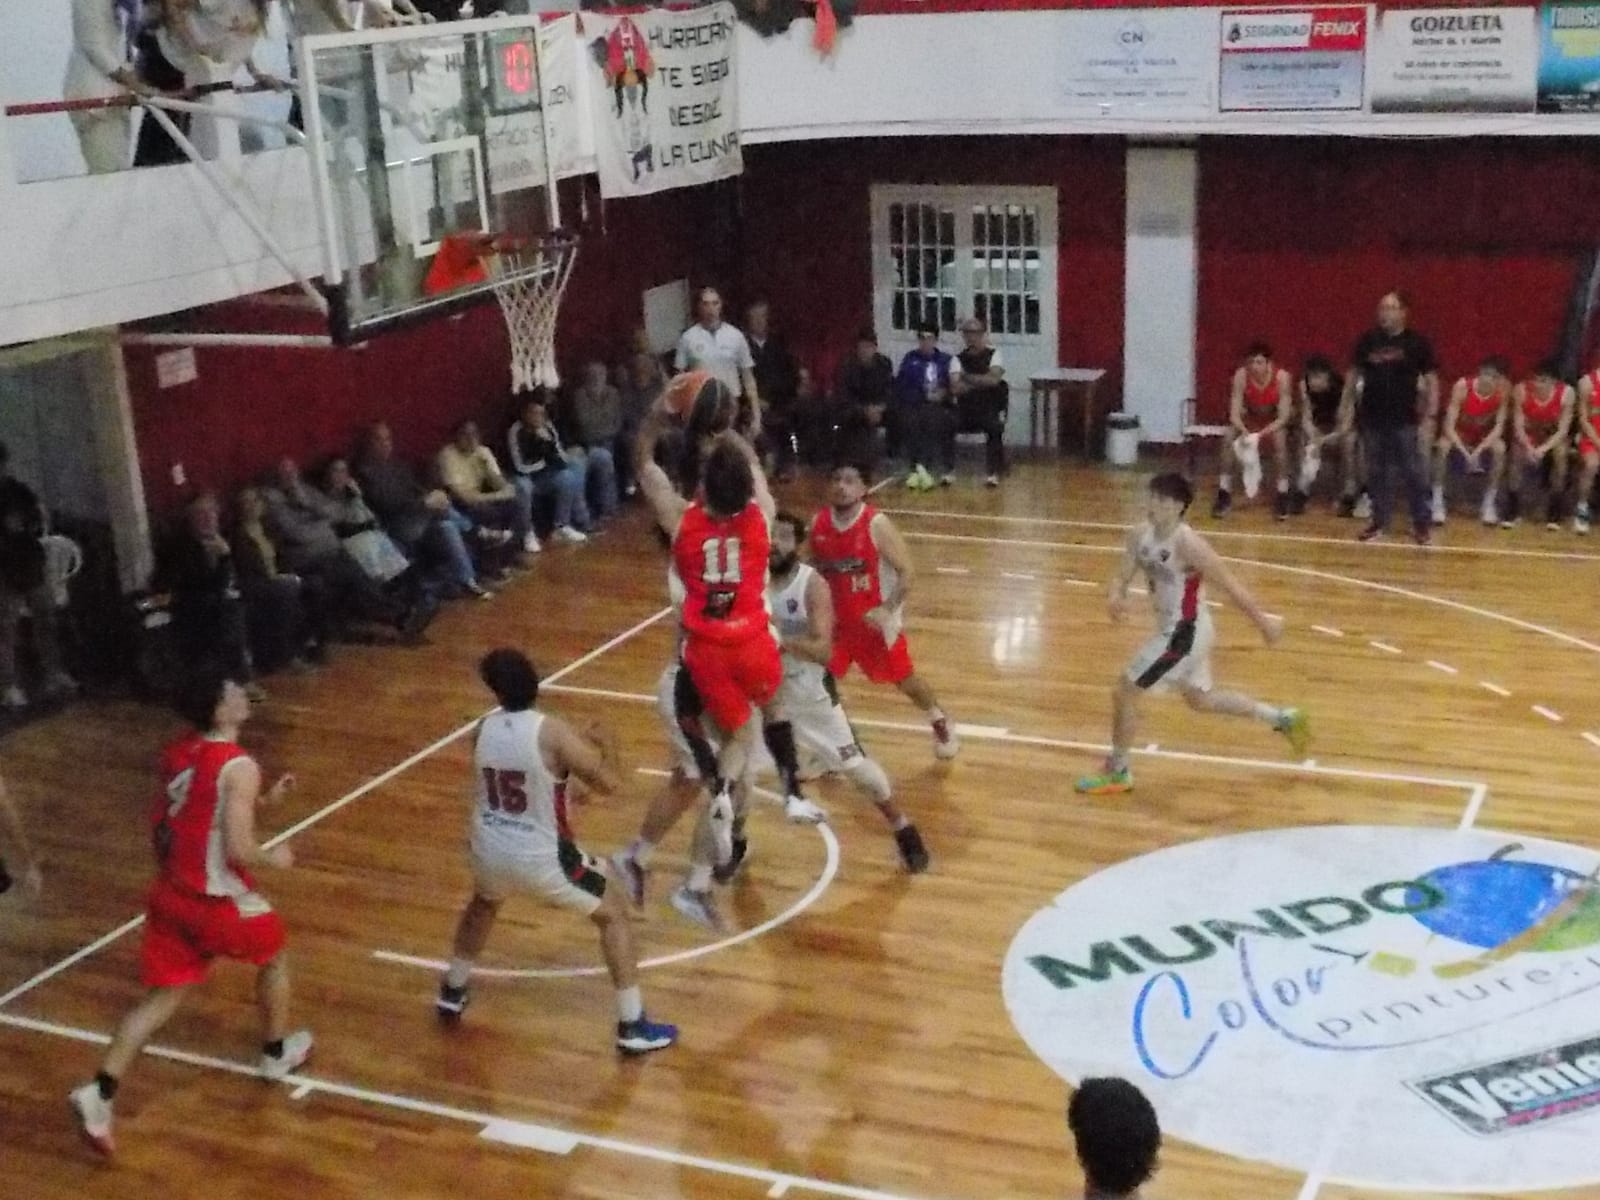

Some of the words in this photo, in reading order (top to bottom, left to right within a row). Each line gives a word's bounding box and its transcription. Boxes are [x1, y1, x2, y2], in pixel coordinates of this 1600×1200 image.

[1121, 31, 1143, 44] CN
[1244, 24, 1309, 38] SEGURIDAD
[1313, 21, 1363, 37] FENIX
[1410, 15, 1503, 33] GOIZUETA
[658, 67, 683, 88] TE
[691, 57, 730, 86] SIGO
[660, 143, 684, 168] LA
[688, 131, 738, 163] CUNA
[702, 538, 742, 584] 11
[482, 767, 528, 815] 15
[1025, 879, 1443, 990] MUNDO
